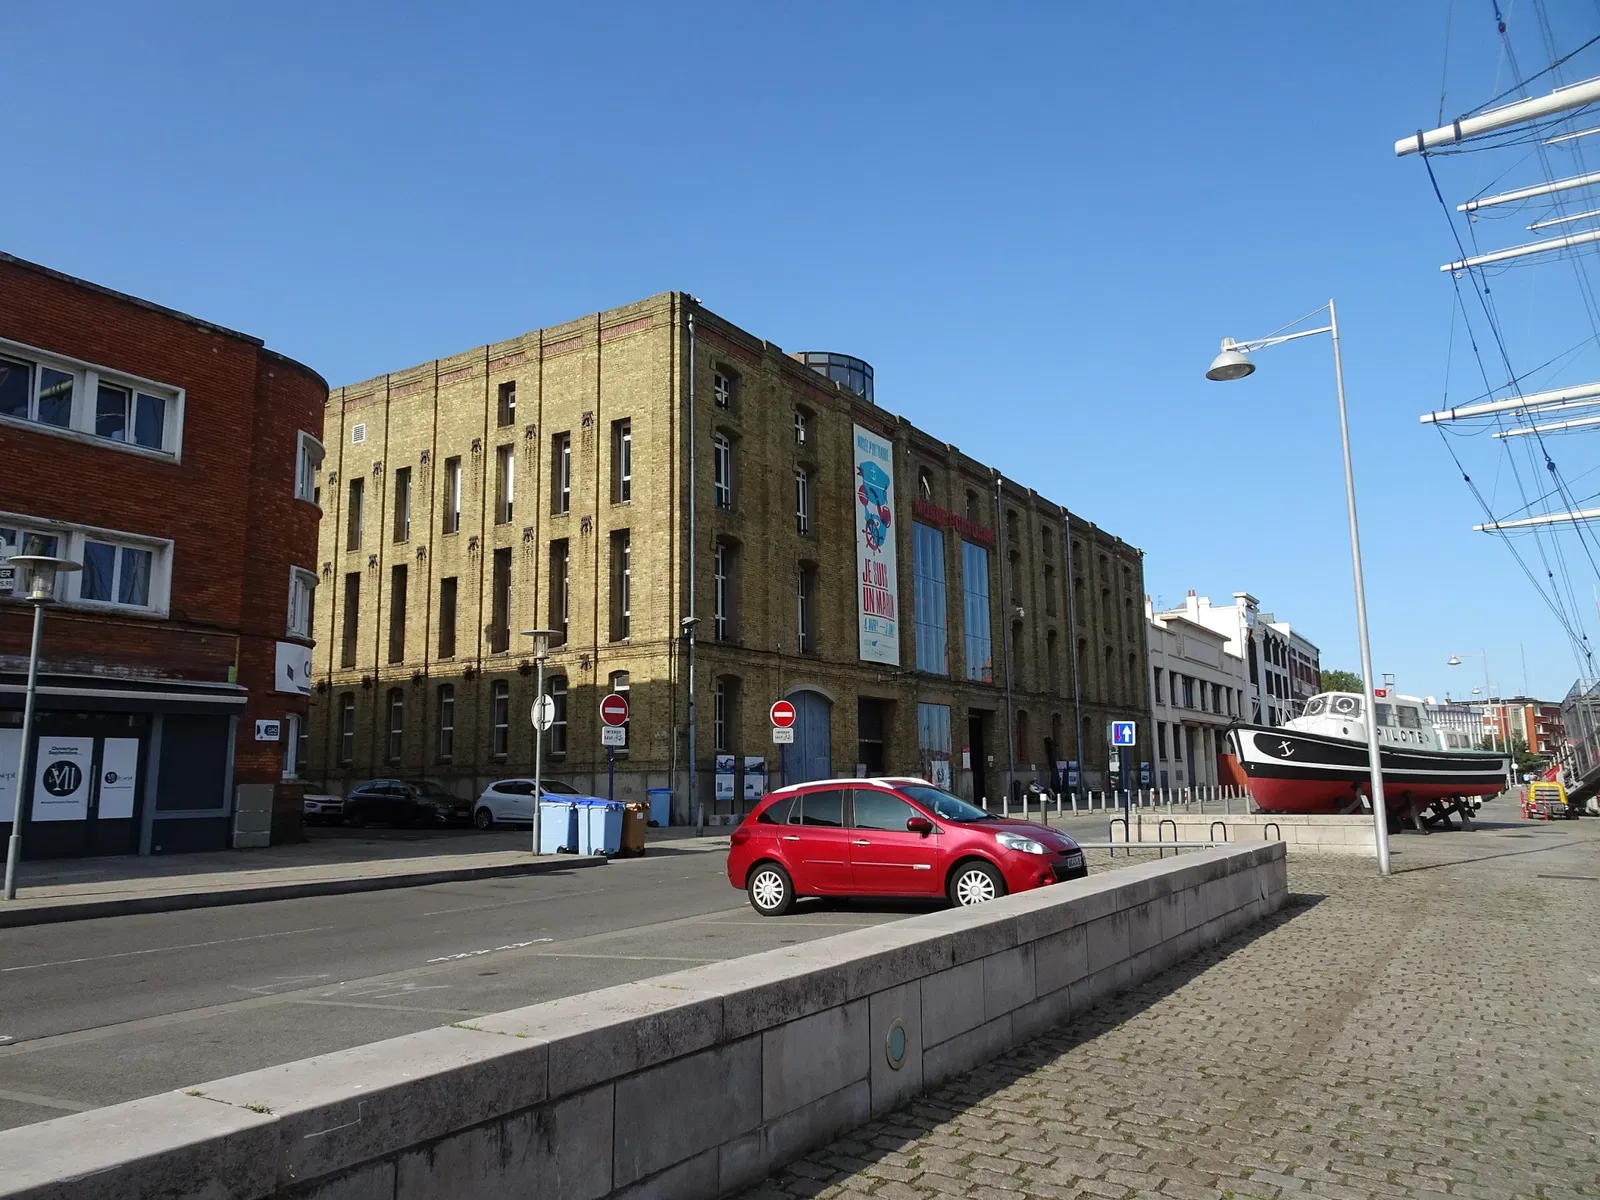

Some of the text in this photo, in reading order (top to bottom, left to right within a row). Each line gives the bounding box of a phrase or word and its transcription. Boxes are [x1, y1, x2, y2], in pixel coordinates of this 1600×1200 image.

[862, 558, 872, 584] JE
[863, 586, 895, 619] UN MARIN
